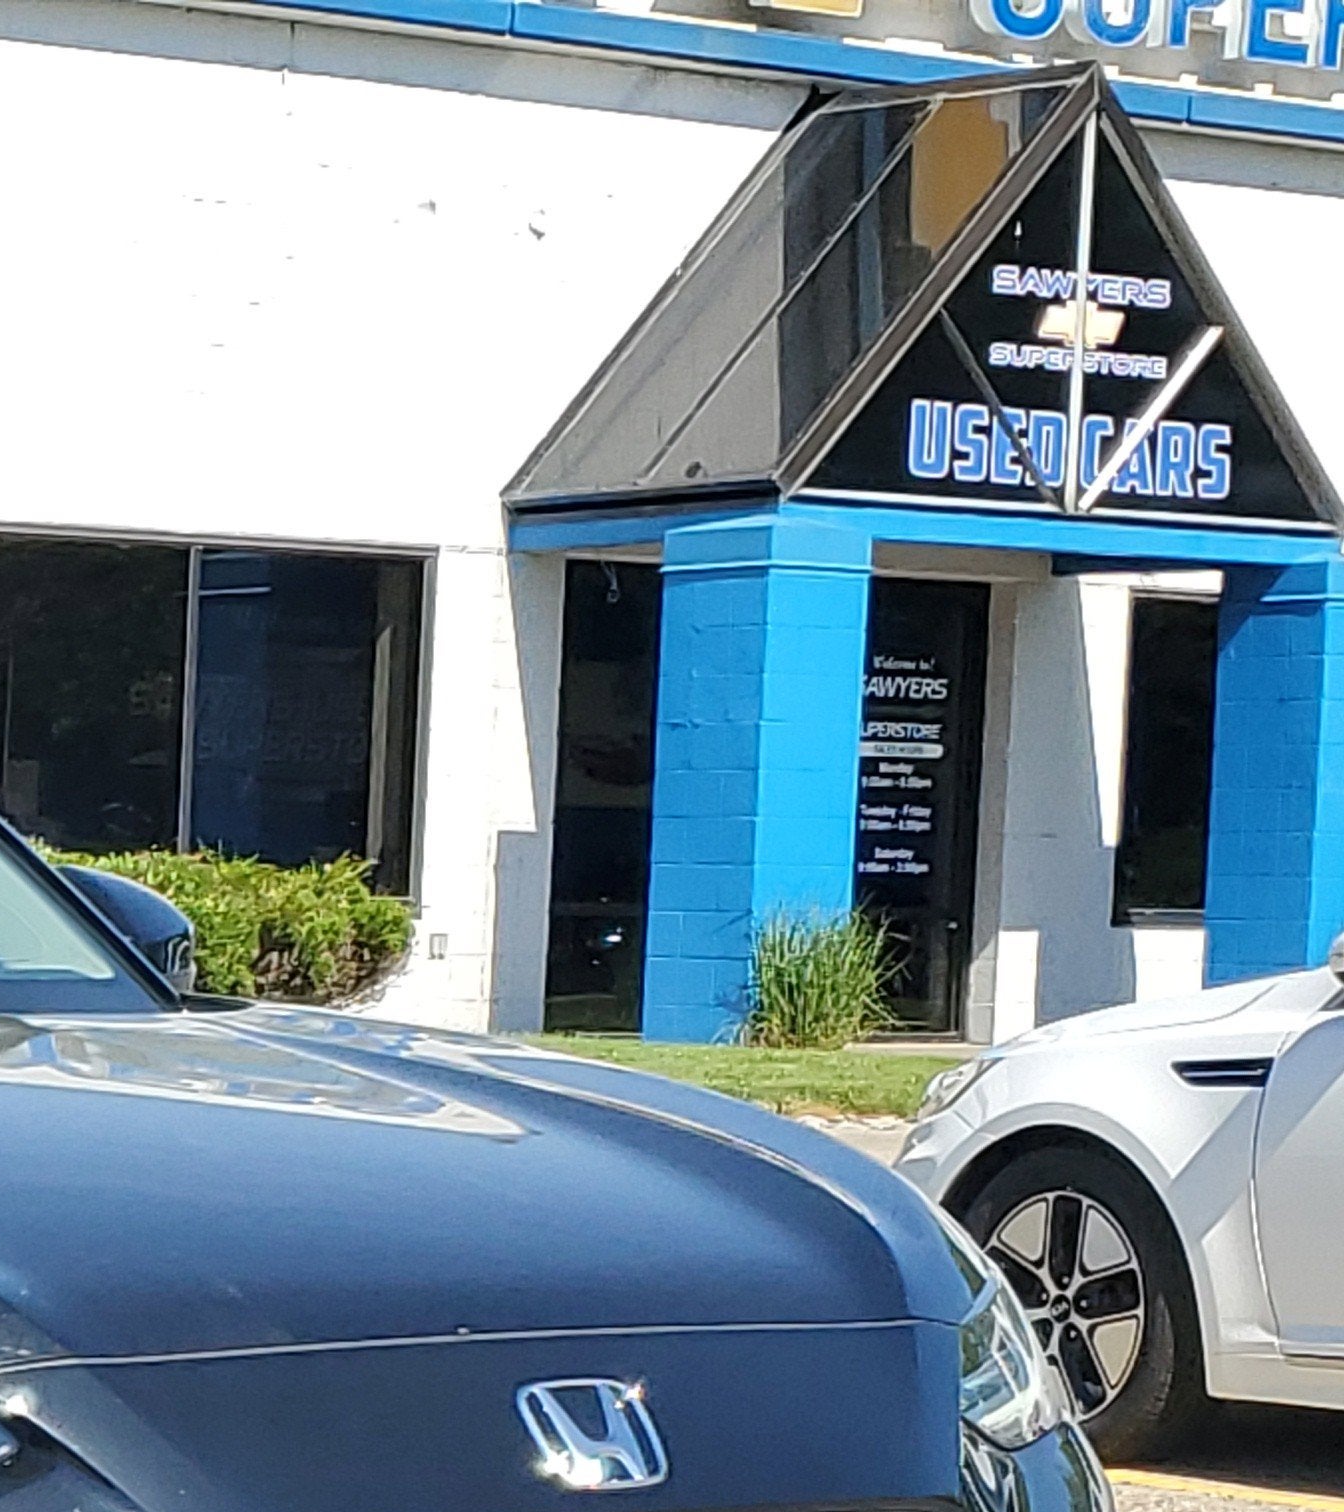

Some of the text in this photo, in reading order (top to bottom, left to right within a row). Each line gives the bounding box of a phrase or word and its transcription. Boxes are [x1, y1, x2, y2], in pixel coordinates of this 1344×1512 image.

[992, 264, 1172, 310] SAWYERS
[908, 397, 1232, 500] USED CARS
[861, 720, 943, 739] UPERSTORE
